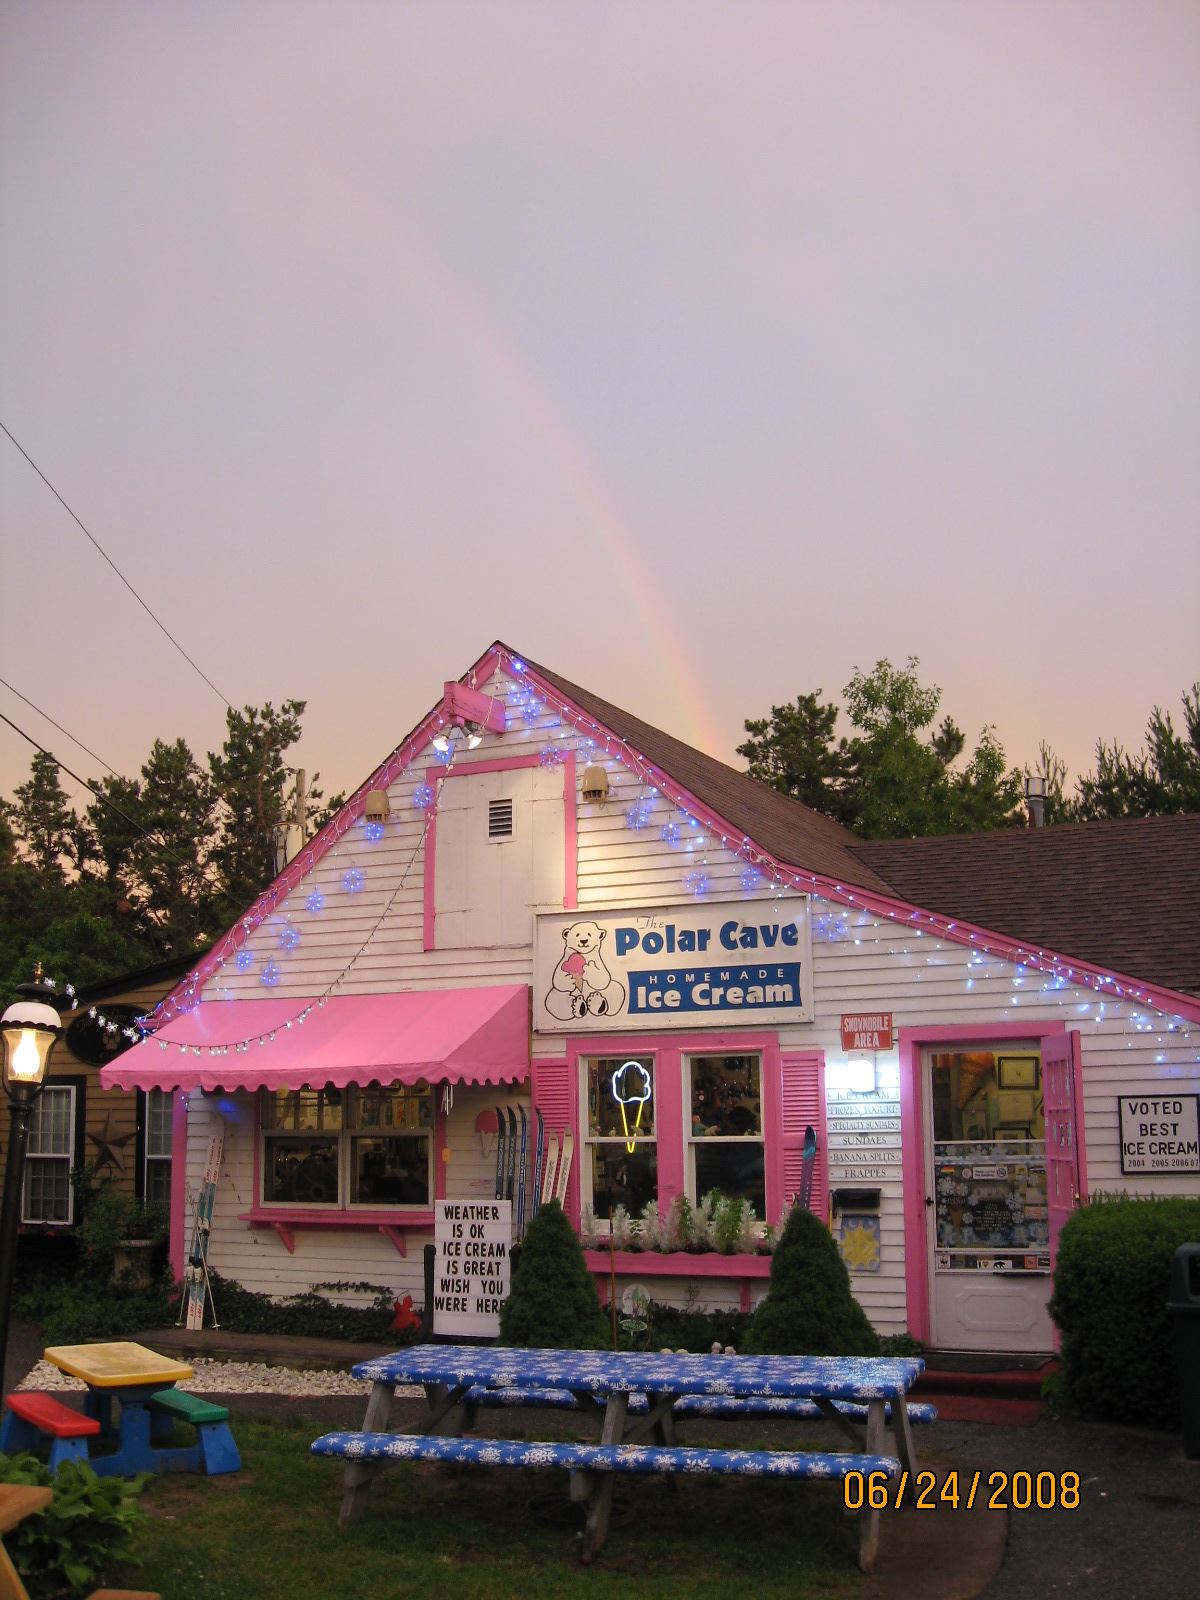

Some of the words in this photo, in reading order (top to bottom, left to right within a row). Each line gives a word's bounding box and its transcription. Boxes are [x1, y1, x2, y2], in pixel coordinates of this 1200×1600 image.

[636, 915, 665, 930] The
[615, 924, 711, 956] Polar
[719, 920, 798, 951] Cave
[649, 968, 784, 985] HOMEMADE
[637, 985, 681, 1009] Ice
[691, 982, 793, 1006] Cream
[844, 1015, 889, 1033] SNOWMOBILE
[854, 1032, 880, 1048] AREA
[830, 1105, 860, 1116] FROZEN
[864, 1105, 896, 1115] YOGURT
[1128, 1101, 1183, 1115] VOTED
[832, 1121, 865, 1130] SPECIALTY
[866, 1120, 895, 1130] SUNDAES
[1139, 1123, 1179, 1136] BEST
[842, 1136, 887, 1146] SUNDAES
[1123, 1142, 1145, 1155] ICE
[1149, 1141, 1198, 1155] CREAM
[833, 1153, 867, 1162] BANANA
[870, 1152, 896, 1161] SPLITS
[1128, 1159, 1145, 1167] 2004
[1151, 1159, 1169, 1167] 2005
[1172, 1159, 1189, 1167] 2006
[844, 1169, 887, 1179] FRAPPES
[444, 1205, 500, 1220] WEATHER
[452, 1224, 463, 1238] IS
[470, 1224, 485, 1239] OK
[443, 1241, 461, 1256] ICE
[465, 1242, 506, 1257] CREAM
[446, 1260, 459, 1275] IS
[464, 1261, 502, 1276] GREAT
[441, 1278, 470, 1294] WISH
[481, 1280, 503, 1295] YOU
[435, 1297, 468, 1312] WERE
